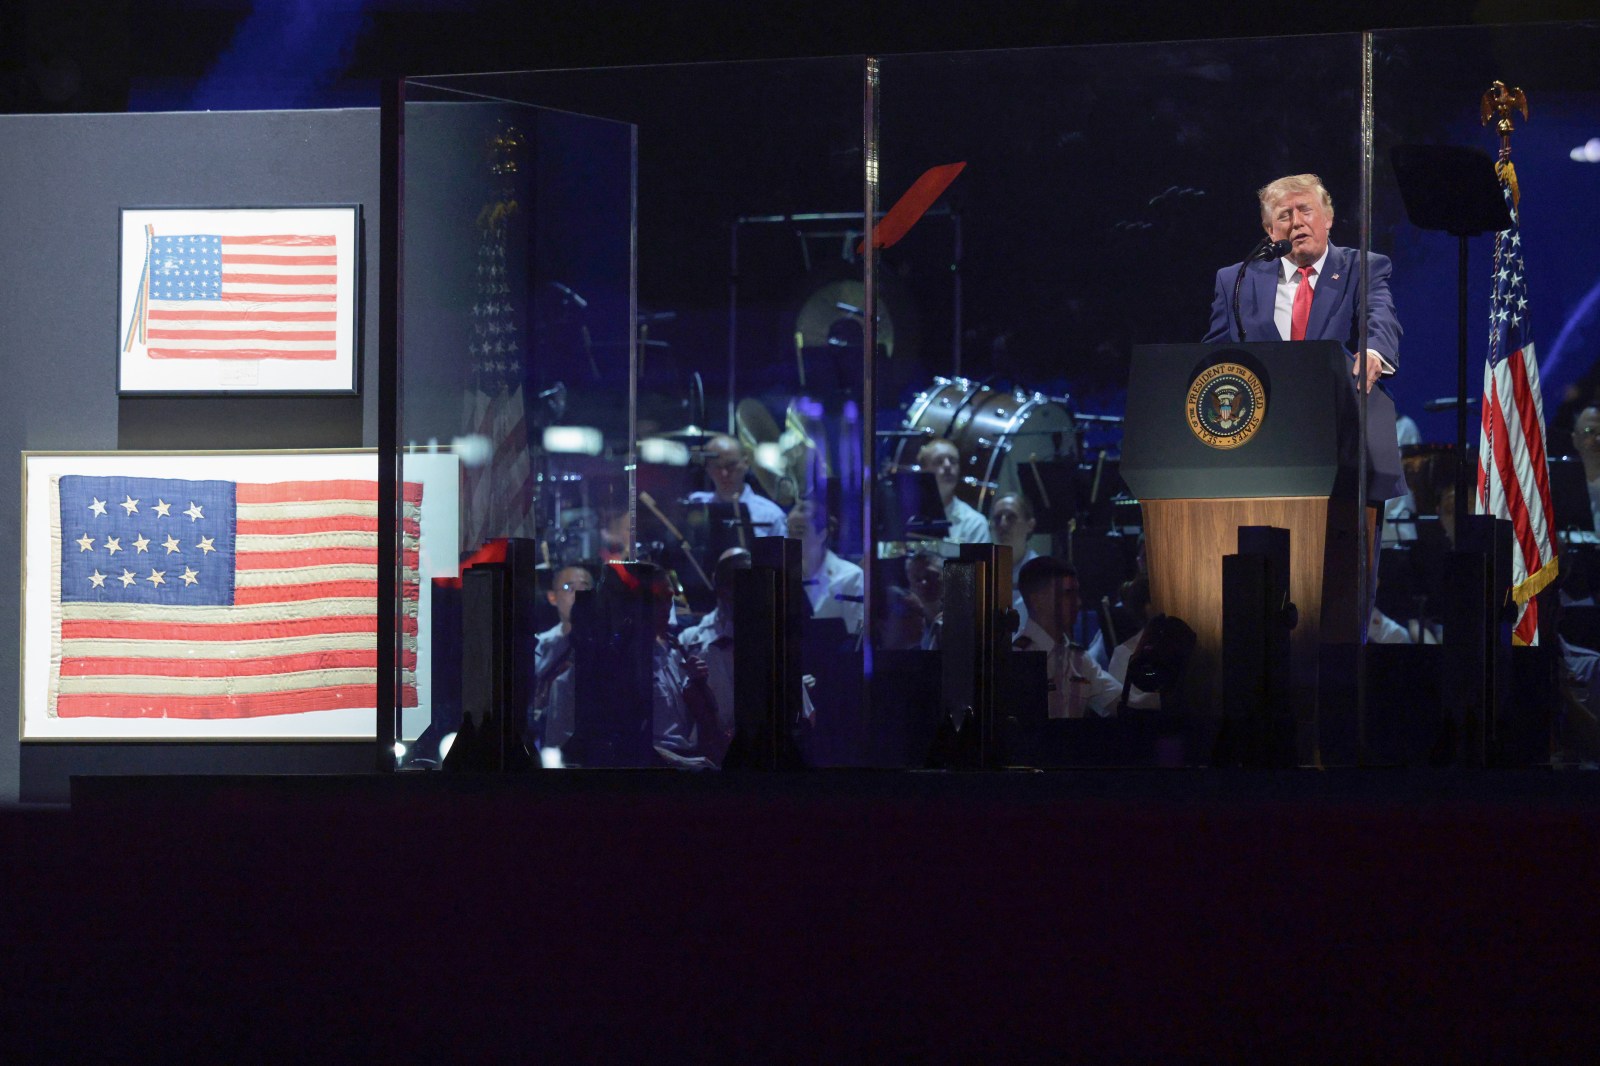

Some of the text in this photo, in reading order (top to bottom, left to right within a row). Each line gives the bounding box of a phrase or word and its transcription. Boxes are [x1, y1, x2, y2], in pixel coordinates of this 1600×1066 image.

[1236, 367, 1246, 376] THE
[1189, 366, 1225, 404] PRESIDENT
[1247, 376, 1264, 409] UNITED
[1191, 419, 1199, 427] OF
[1232, 416, 1259, 444] STATES
[1198, 426, 1217, 445] SEAL
